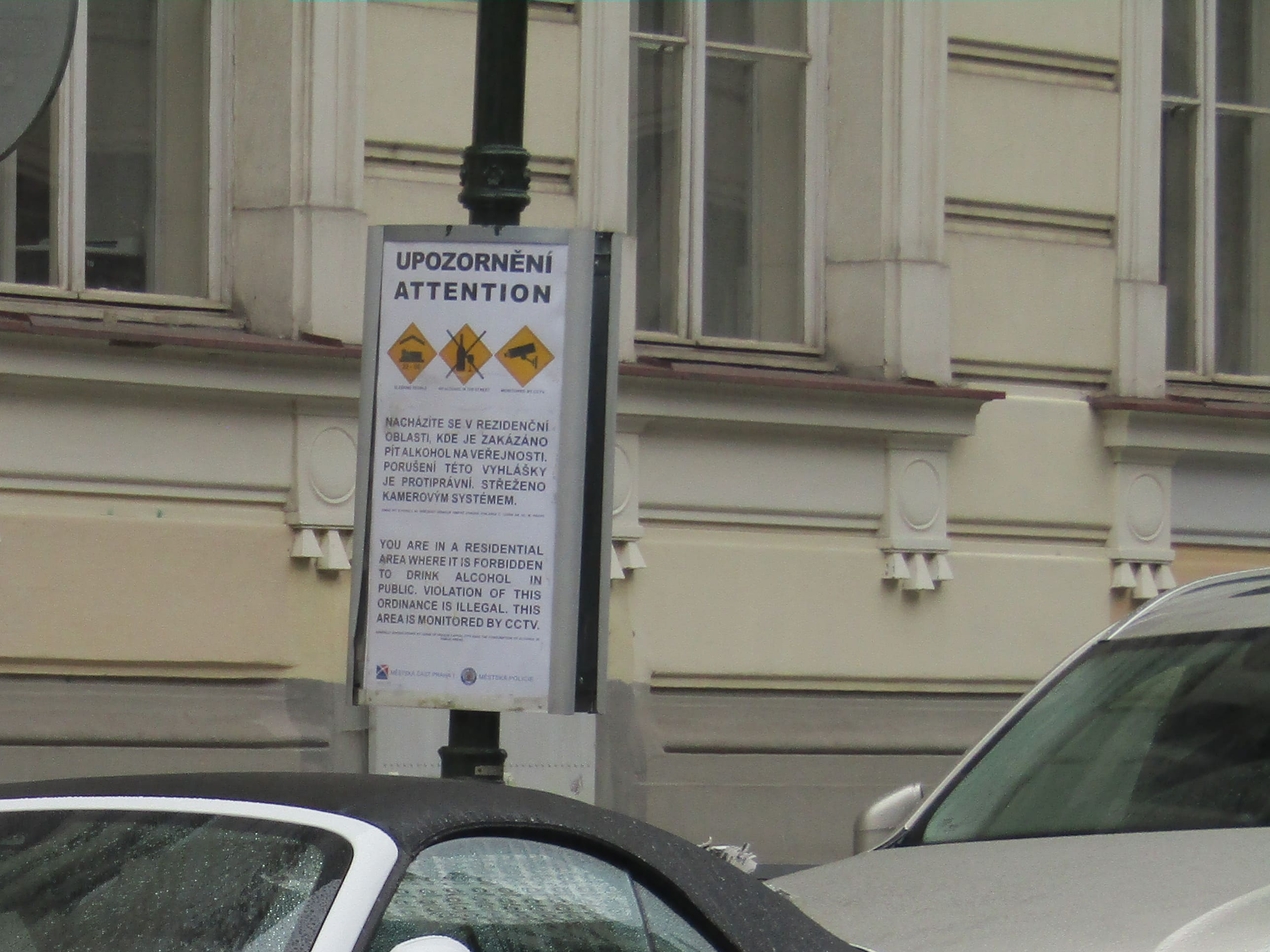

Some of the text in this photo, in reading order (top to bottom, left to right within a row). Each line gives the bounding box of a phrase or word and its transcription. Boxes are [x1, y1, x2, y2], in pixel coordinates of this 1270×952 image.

[396, 250, 552, 273] UPOZORNĚNÍ
[394, 281, 551, 303] ATTENTION
[386, 417, 549, 432] NACHÁZÍTE SE V REZIDENČNÍ
[385, 432, 548, 447] OBLASTI, KDE JE ZAKÁZÁNO
[385, 446, 547, 462] PÍT ALKOHOL NA VEŘEJNOSTI.
[384, 460, 547, 476] PORUŠENÍ TÉTO VYHLÁŠKY
[383, 476, 546, 491] JE PROTIPRÁVNÍ. STŘEŽENO
[383, 491, 517, 505] KAMEROVÝM SYSTÉMEM.
[380, 539, 543, 555] YOU ARE IN A RESIDENTIAL
[379, 554, 542, 570] AREA WHERE IT IS FORBIDDEN
[379, 569, 542, 585] TO DRINK ALCOHOL IN
[378, 583, 541, 600] PUBLIC. VIOLATION OF THIS
[377, 598, 540, 615] ORDINANCE IS ILLEGAL. THIS
[377, 614, 539, 630] AREA IS MONITORED BY CCTV.
